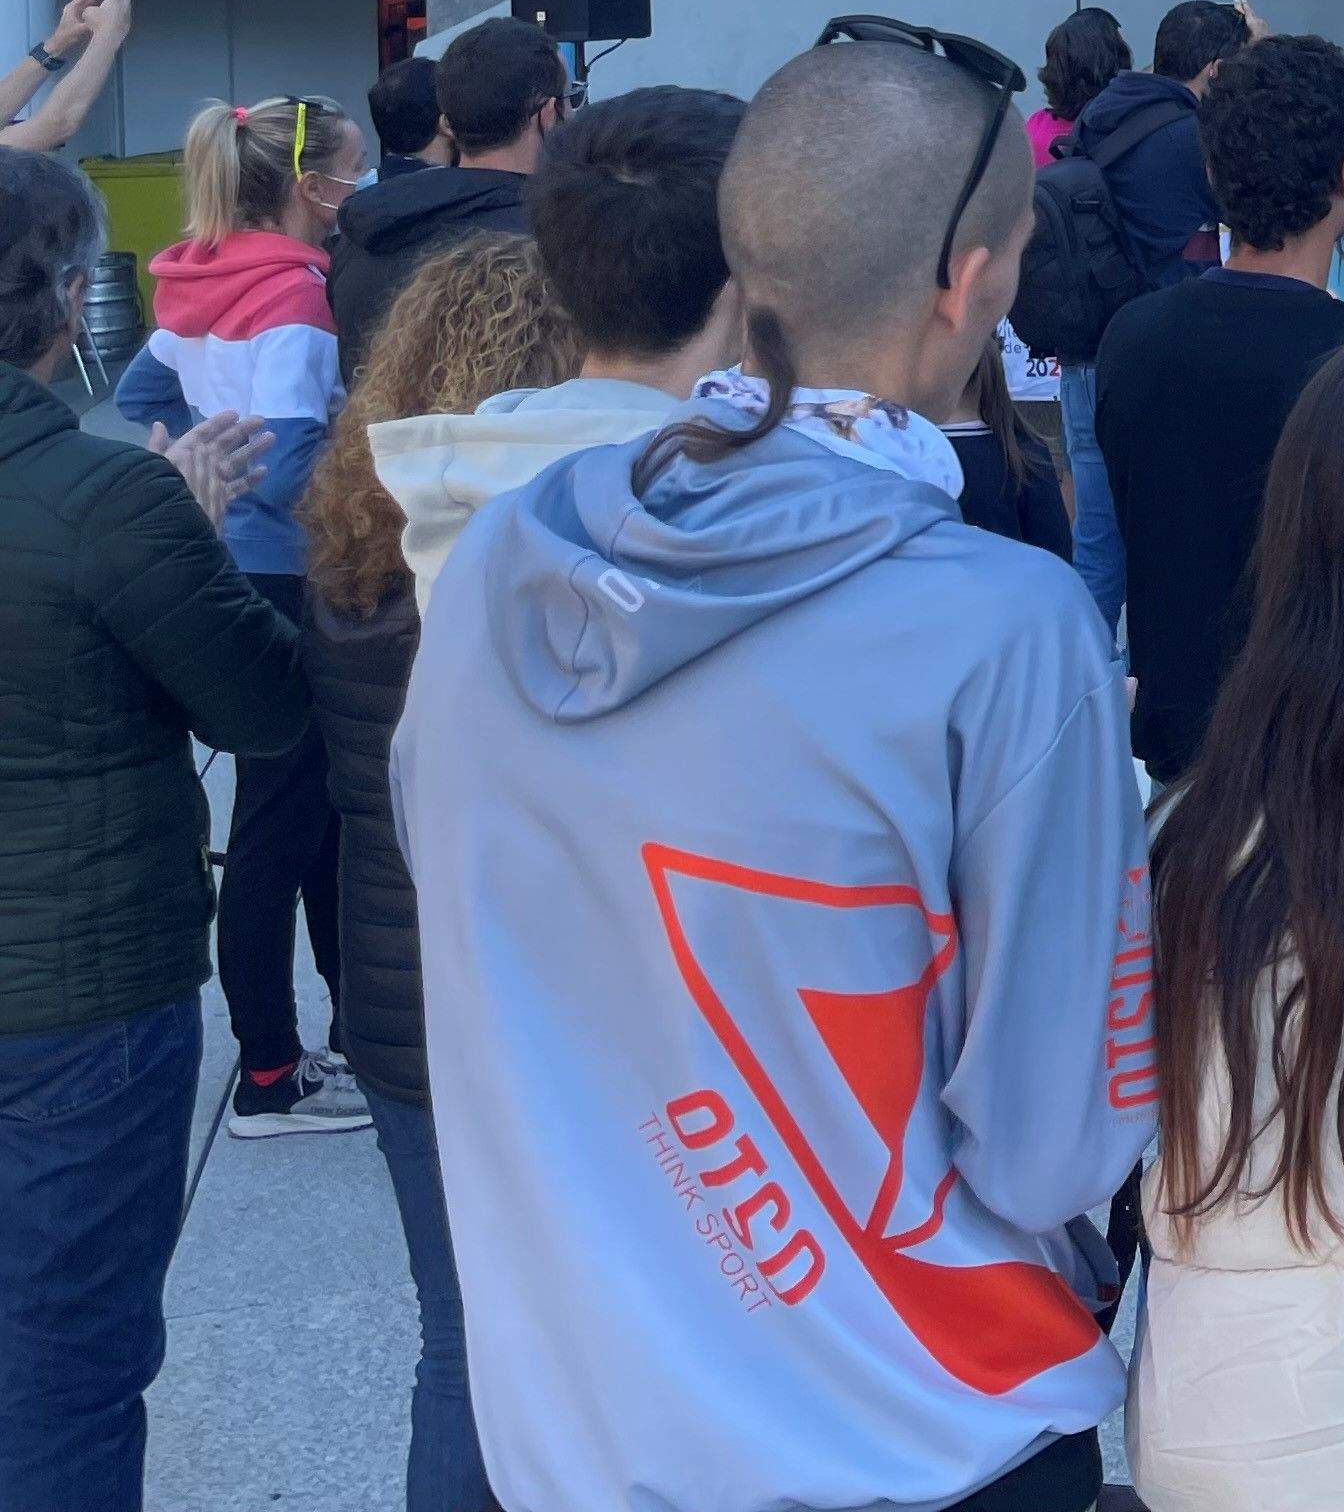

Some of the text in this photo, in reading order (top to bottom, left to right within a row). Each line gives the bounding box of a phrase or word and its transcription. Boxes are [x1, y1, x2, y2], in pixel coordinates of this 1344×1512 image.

[1026, 358, 1061, 378] 202
[638, 1110, 773, 1314] THINK SPORT
